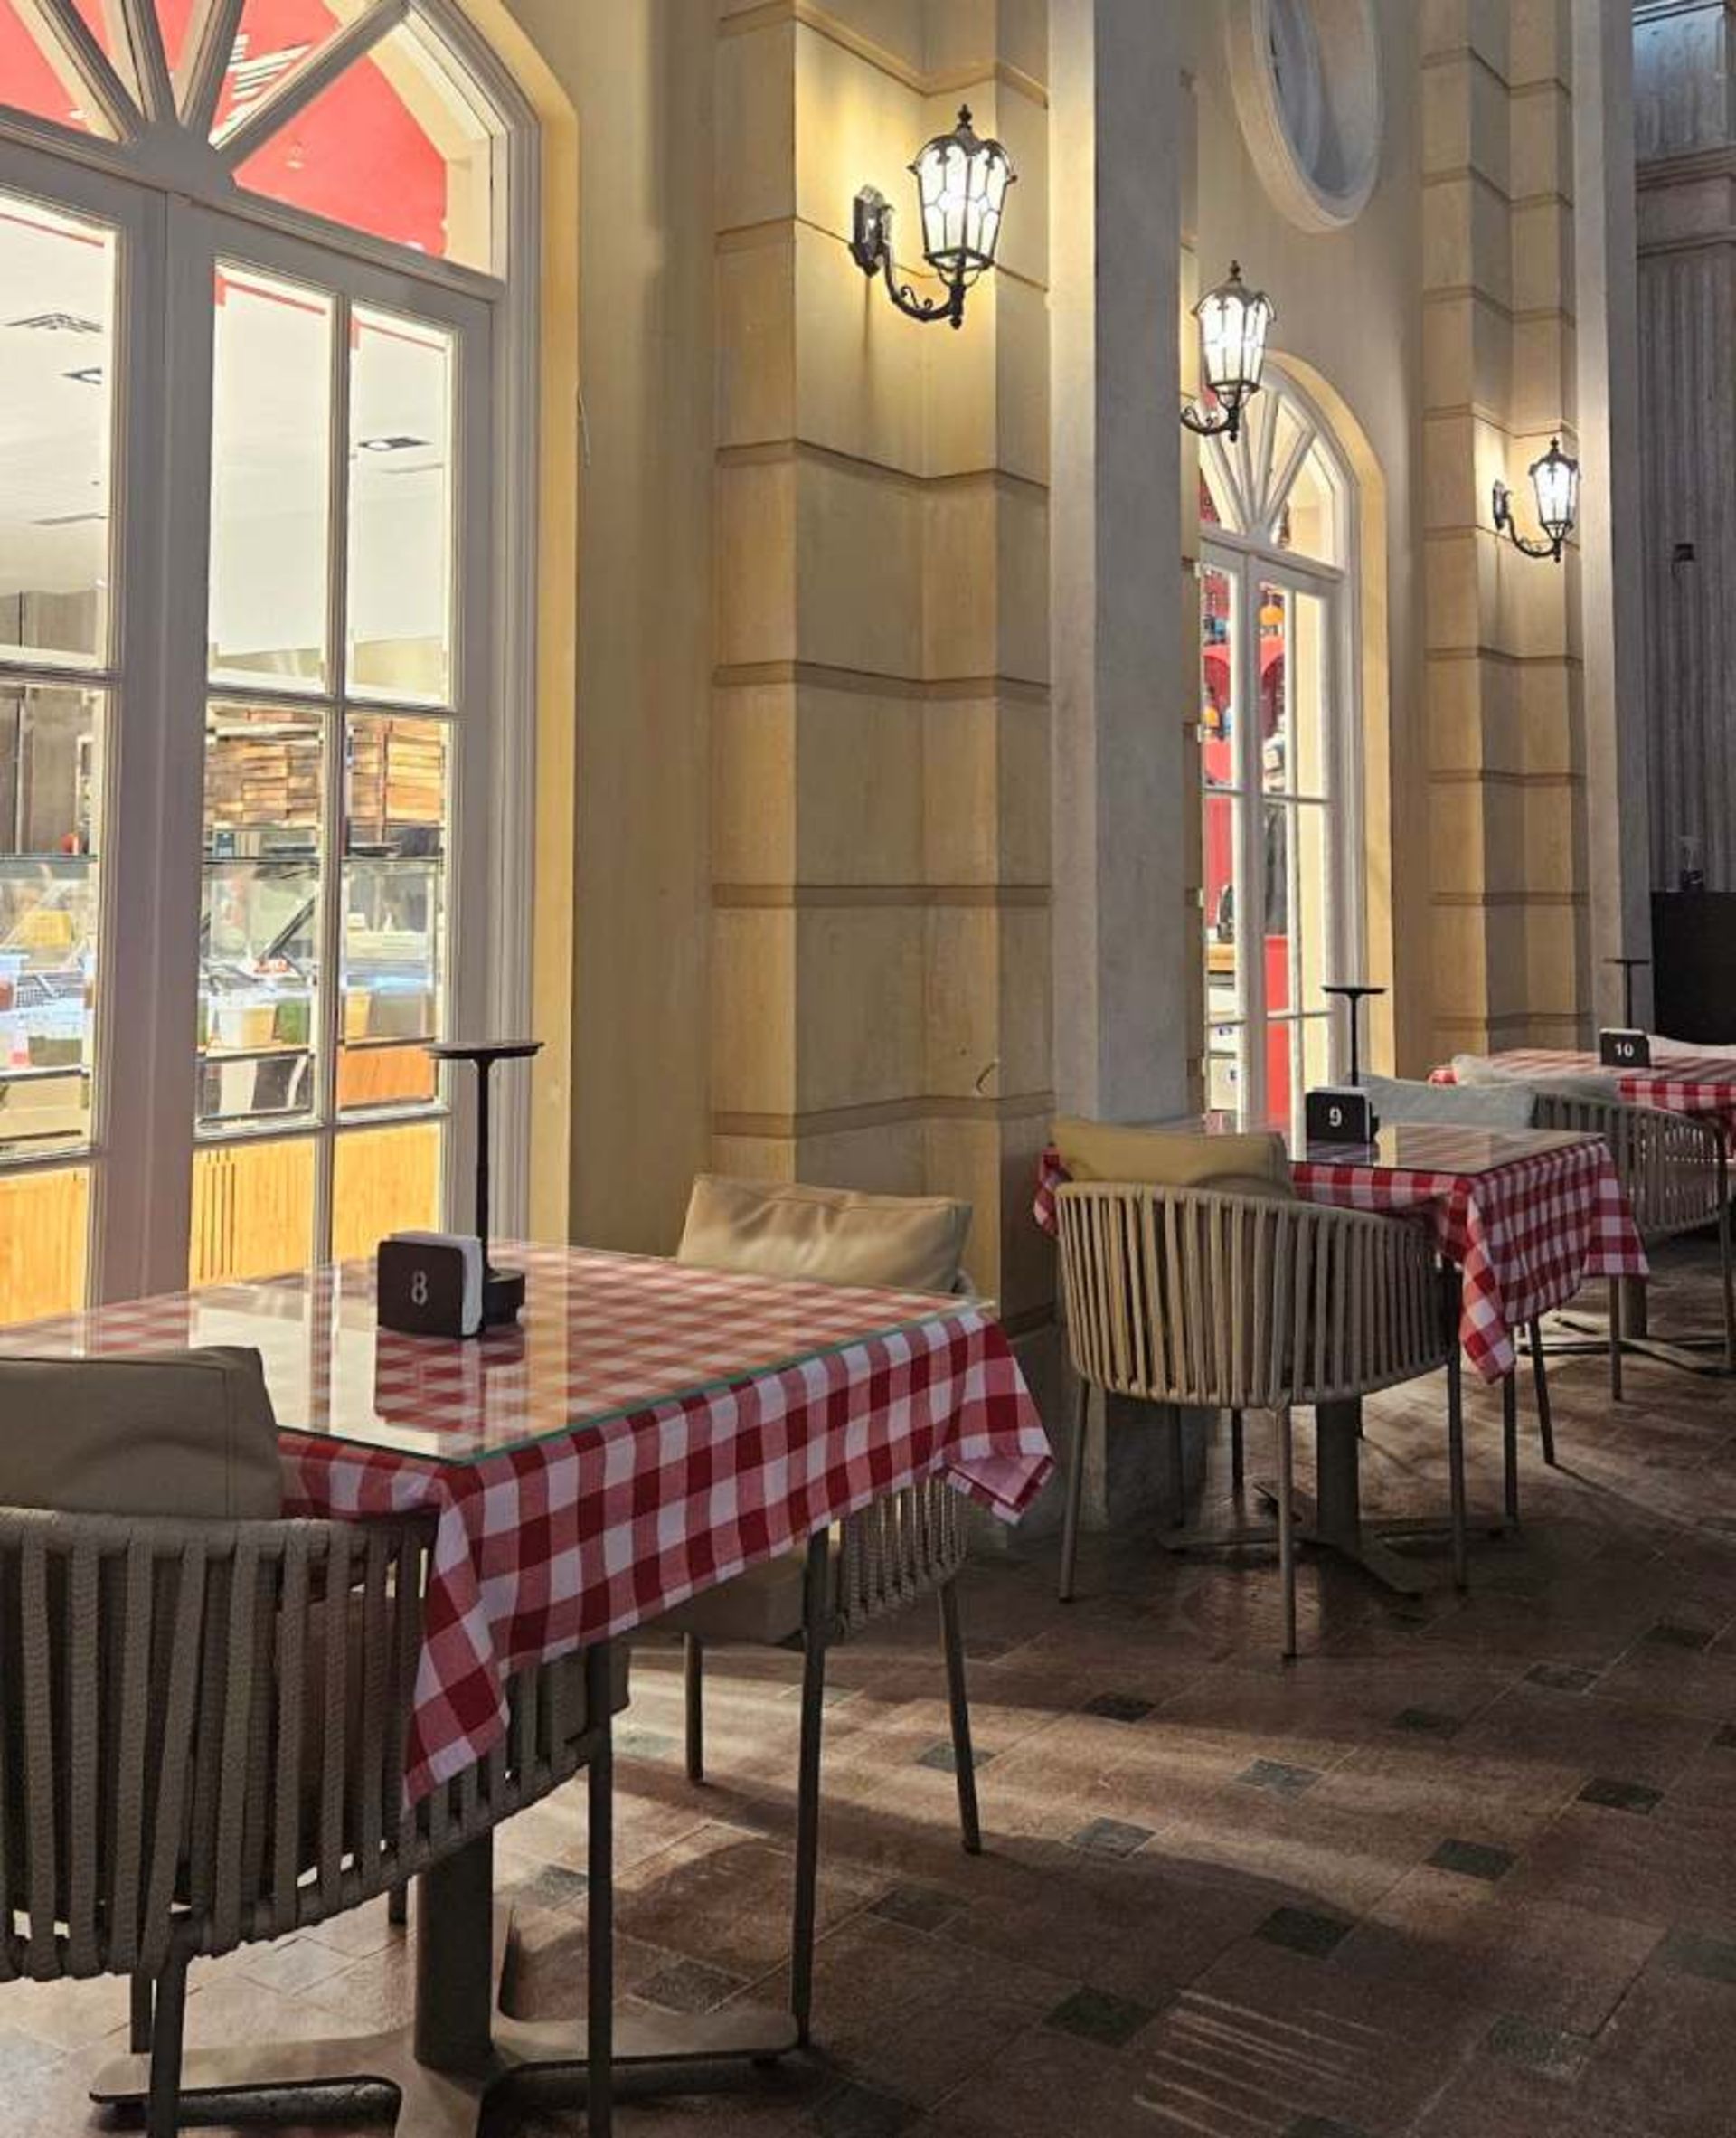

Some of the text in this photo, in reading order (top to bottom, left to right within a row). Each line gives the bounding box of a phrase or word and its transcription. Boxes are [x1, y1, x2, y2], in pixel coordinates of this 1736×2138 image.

[1615, 1042, 1635, 1058] 10
[1329, 1106, 1343, 1127] 9
[411, 1270, 429, 1305] 8
